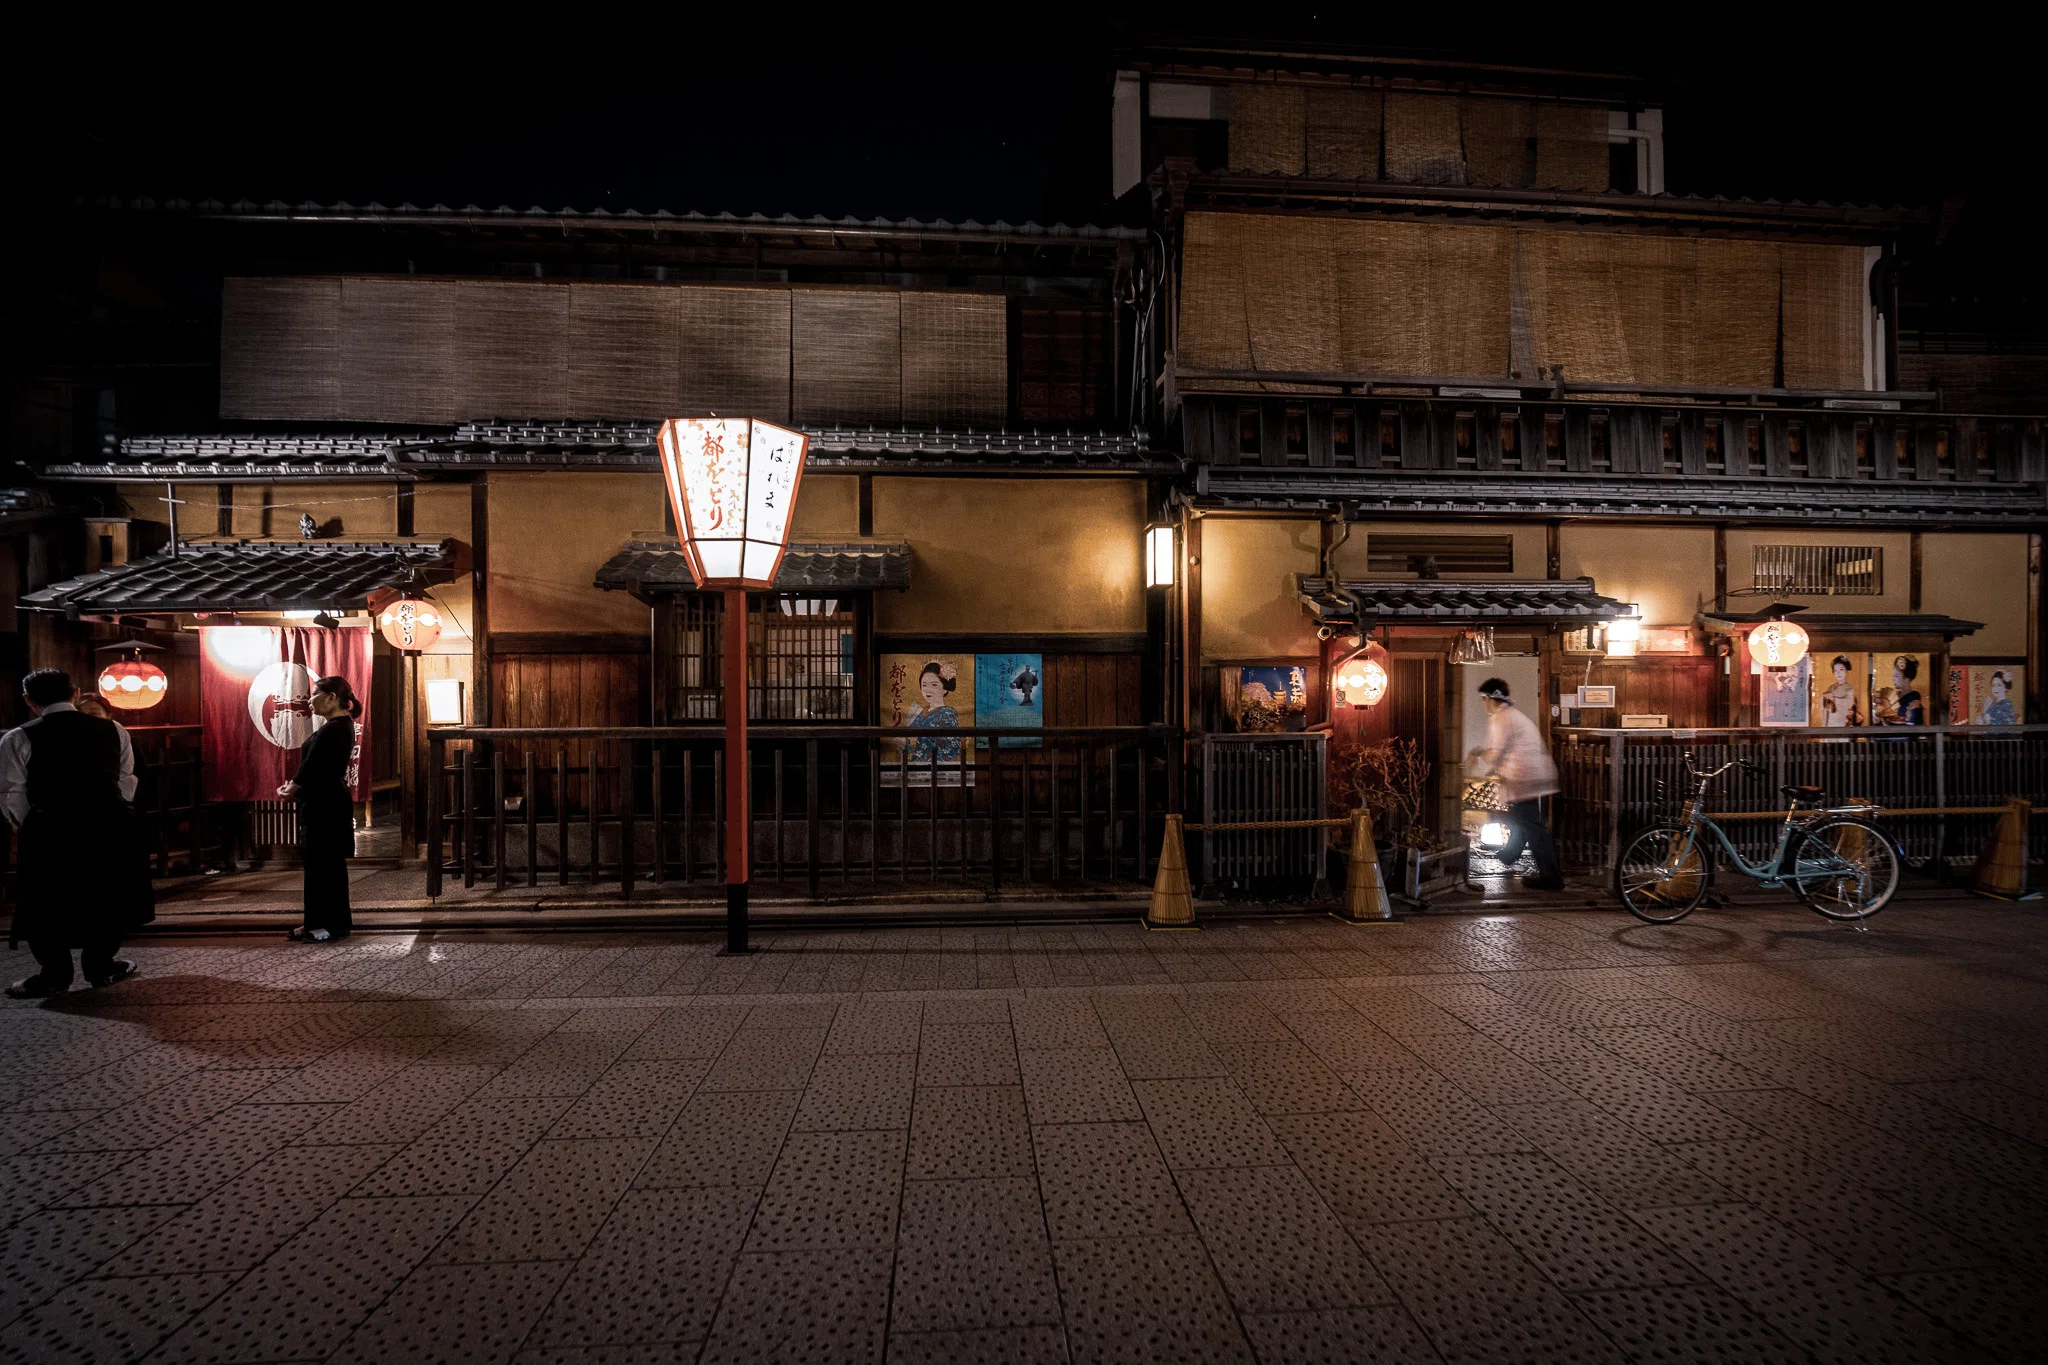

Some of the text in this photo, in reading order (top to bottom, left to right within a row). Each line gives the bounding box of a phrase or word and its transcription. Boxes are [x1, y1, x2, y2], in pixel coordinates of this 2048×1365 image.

[701, 431, 726, 531] 都をどり
[765, 446, 783, 509] はれま
[889, 661, 907, 728] 都をどり
